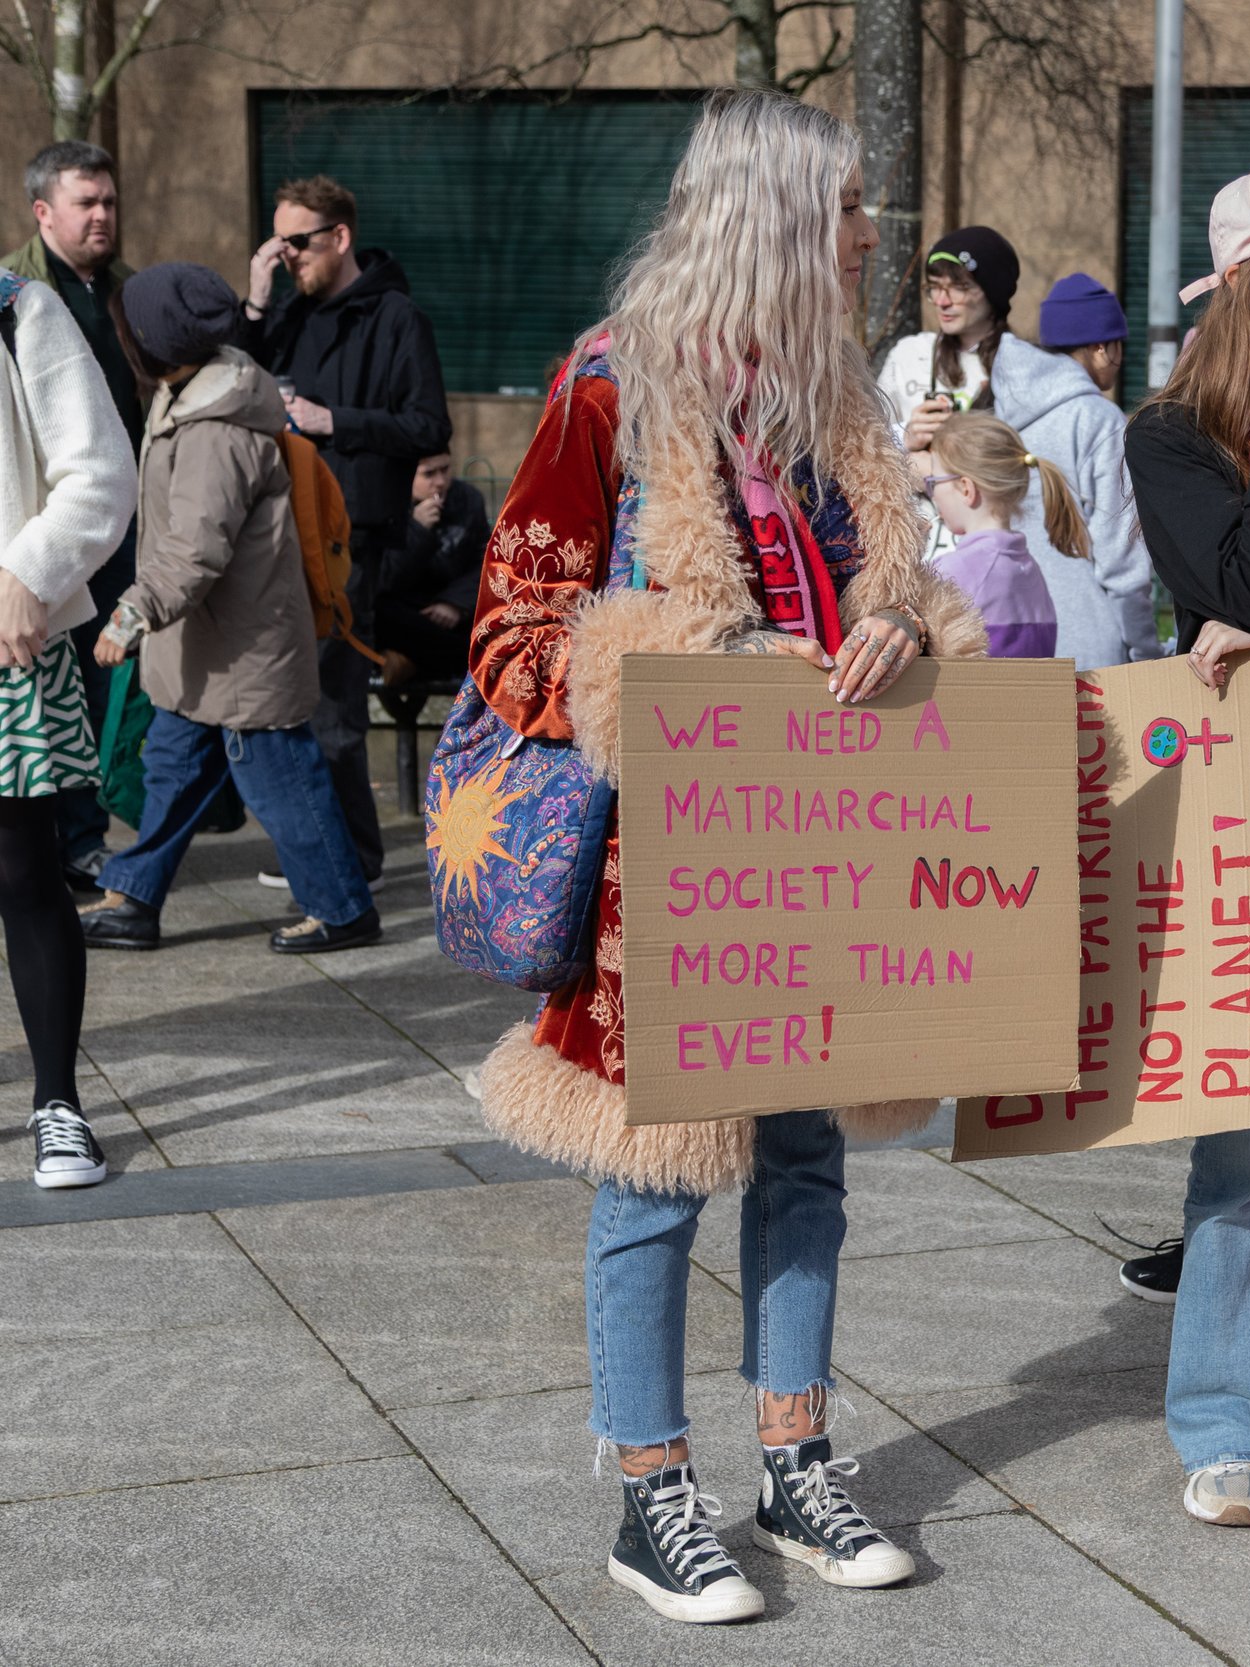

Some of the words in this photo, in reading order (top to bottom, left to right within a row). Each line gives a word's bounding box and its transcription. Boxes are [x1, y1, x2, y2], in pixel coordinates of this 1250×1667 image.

[751, 511, 808, 638] ERS
[654, 704, 742, 750] WE
[786, 709, 882, 755] NEED
[913, 699, 951, 751] A
[665, 779, 991, 835] MATRIARCHAL
[667, 860, 875, 918] SOCIETY
[909, 856, 1040, 910] NOW
[1136, 859, 1185, 973] THE
[670, 942, 812, 989] MORE
[848, 943, 974, 986] THAN
[678, 1005, 835, 1073] EVER!
[1065, 1002, 1114, 1121] THE
[1136, 989, 1186, 1103] NOT
